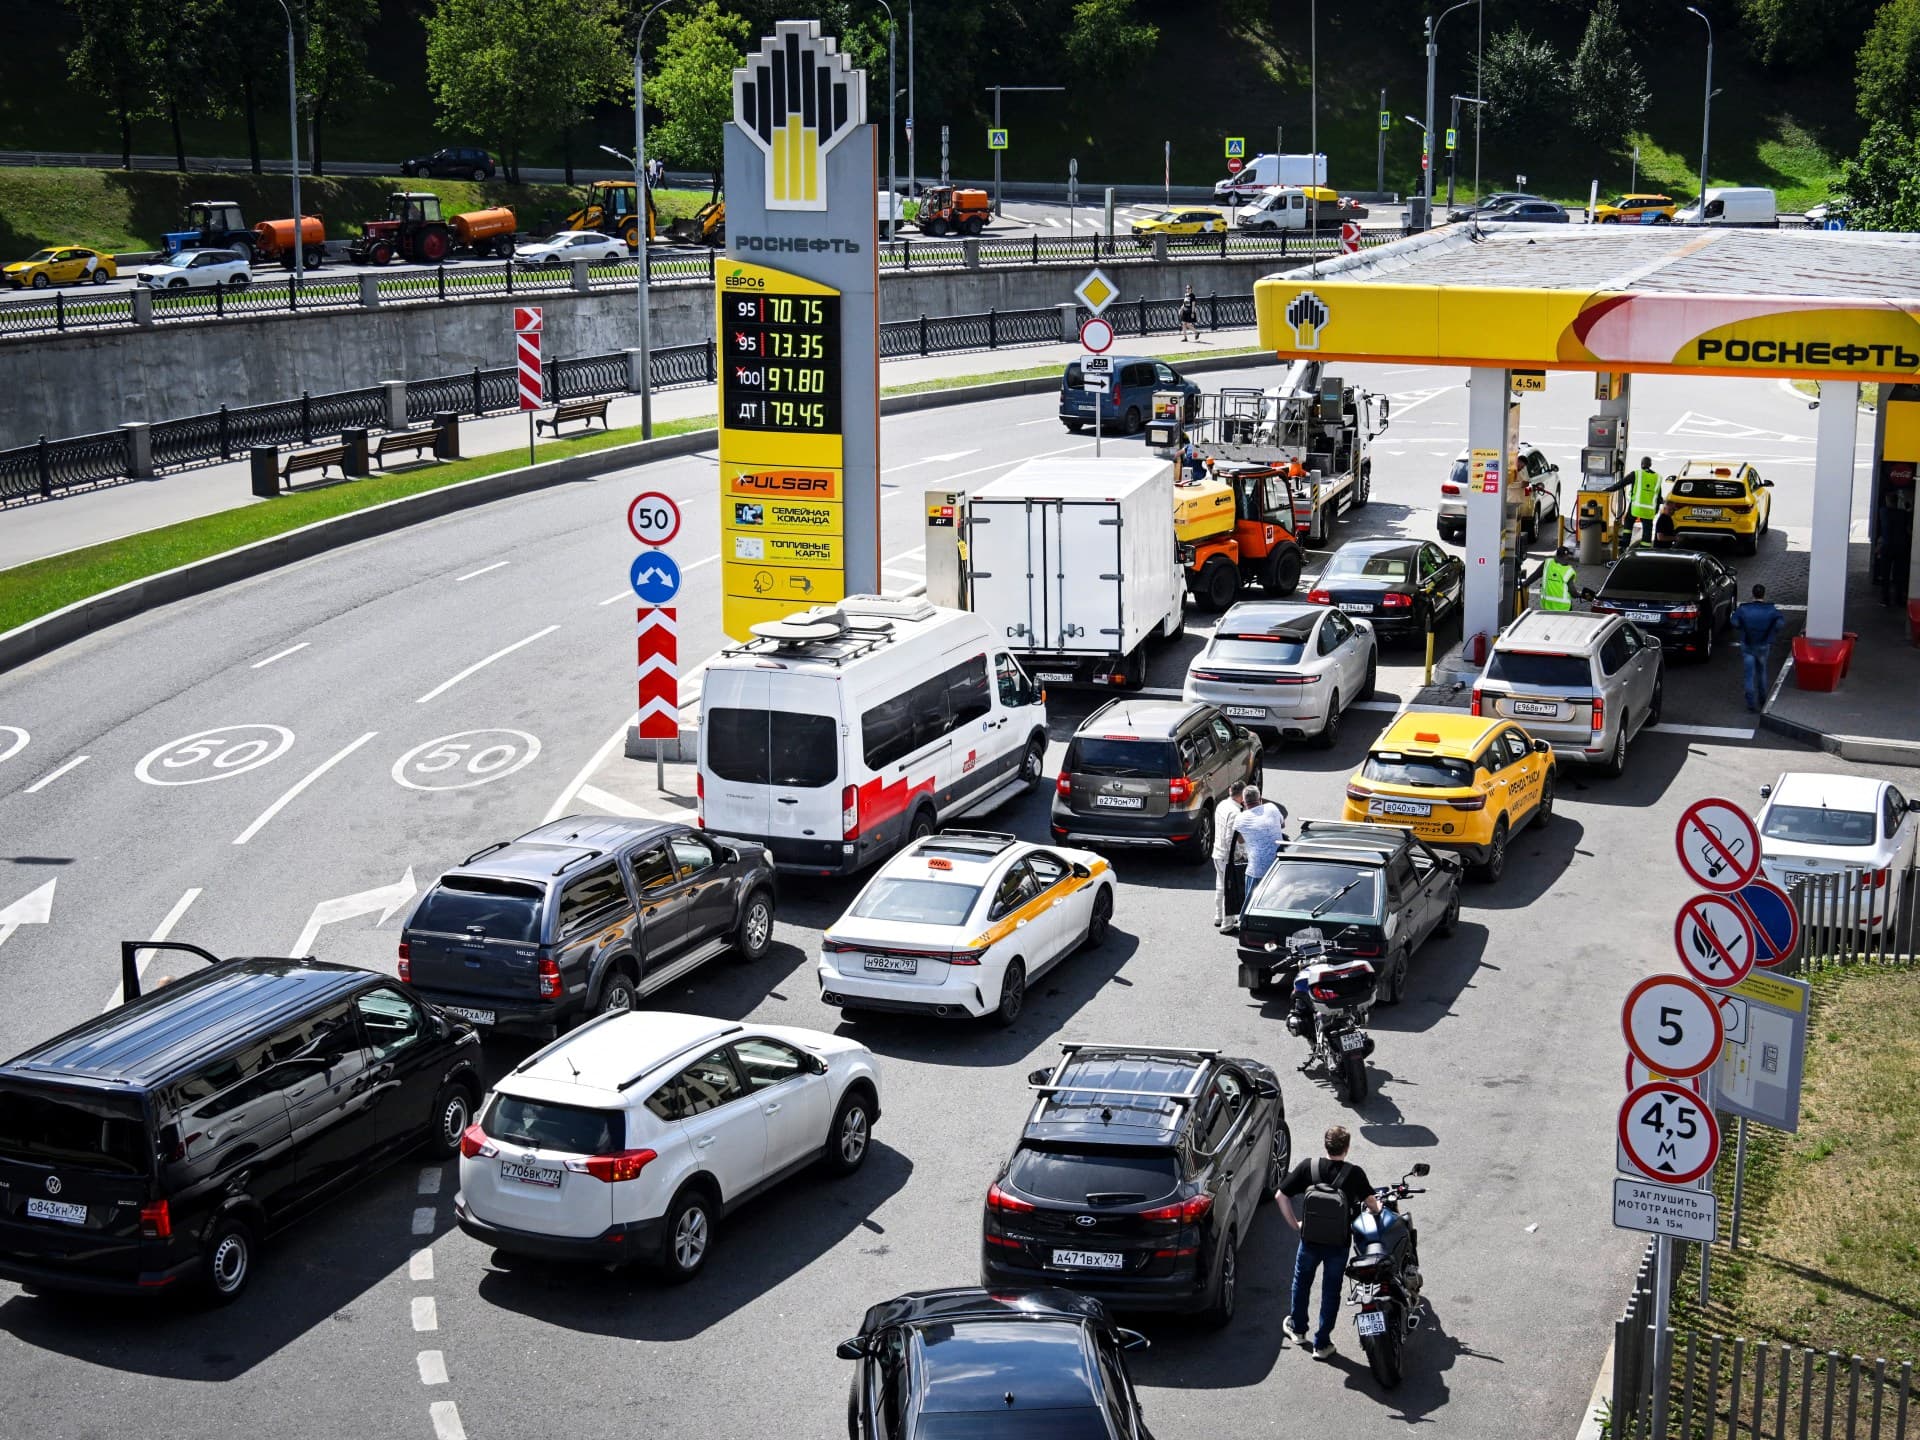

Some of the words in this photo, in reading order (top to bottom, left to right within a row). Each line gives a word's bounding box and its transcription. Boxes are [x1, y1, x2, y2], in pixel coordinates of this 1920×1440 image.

[735, 236, 860, 253] РОСНЕФТЬ
[738, 302, 756, 317] 95
[769, 298, 823, 324] 70.75
[739, 336, 757, 351] 95
[769, 333, 823, 359] 73.35
[1698, 339, 1920, 368] РОСНЕФТЬ
[768, 367, 824, 393] 97.80
[738, 403, 758, 419] ДТ
[770, 401, 824, 428] 79.45
[771, 506, 830, 517] СЕМЕЙНАЯ
[946, 494, 956, 505] 5
[639, 507, 669, 530] 50
[777, 515, 830, 525] КОМАНДА
[770, 540, 831, 551] ТОПЛИВНЫЕ
[795, 549, 831, 559] КАРТЫ
[162, 739, 269, 768] 50
[415, 743, 516, 773] 50
[1657, 1005, 1684, 1046] 5
[1641, 1102, 1697, 1140] 4,5
[1632, 1189, 1698, 1208] ЗАГЛУШИТЬ
[1618, 1199, 1712, 1223] МОТОТРАНСПОРТ
[1646, 1215, 1660, 1226] ЗА
